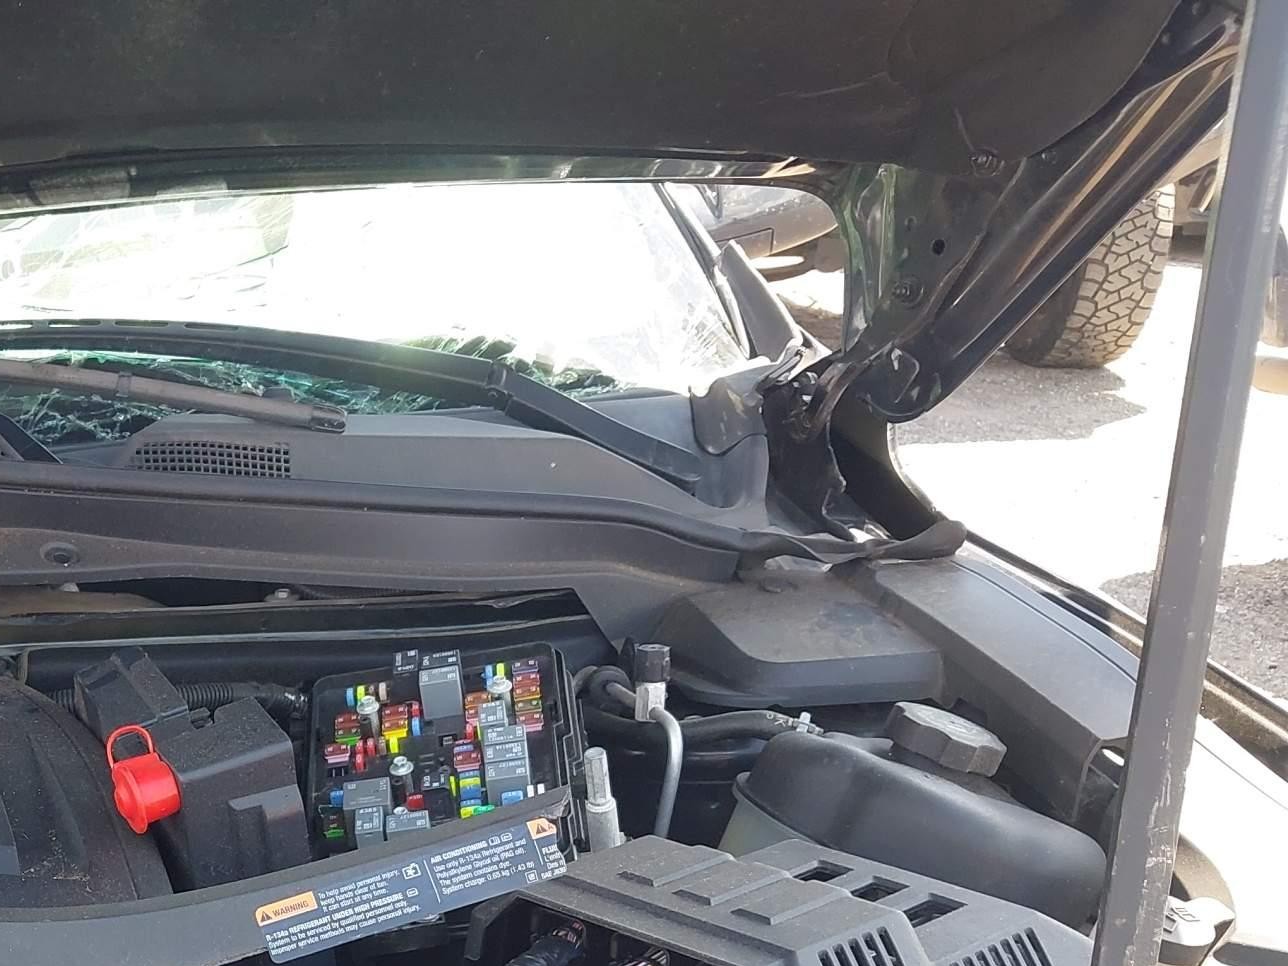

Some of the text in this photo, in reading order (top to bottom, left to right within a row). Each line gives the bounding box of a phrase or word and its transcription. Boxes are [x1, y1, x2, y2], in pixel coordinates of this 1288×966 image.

[431, 841, 487, 864] AIR CONDITIONING
[446, 860, 458, 868] only
[459, 853, 481, 864] R-134a
[482, 842, 514, 857] Refrigerant
[515, 838, 526, 847] and
[326, 889, 339, 897] help
[340, 883, 356, 893] avoid
[356, 875, 381, 888] personal
[439, 861, 512, 888] The system contains dye.
[320, 897, 335, 906] keep
[335, 891, 353, 901] hands
[354, 887, 368, 895] clear
[442, 884, 464, 894] System
[266, 893, 403, 941] R-134a REFRIGERANT UNDER HIGH PRESSURE
[272, 901, 309, 917] WARNING
[269, 938, 290, 949] System
[307, 924, 331, 936] serviced
[340, 913, 365, 926] qualified
[365, 904, 394, 919] personnel
[271, 943, 296, 955] Improper
[298, 937, 319, 948] service
[320, 928, 345, 940] methods
[345, 923, 358, 932] may
[359, 918, 376, 928] cause
[377, 909, 402, 923] personal
